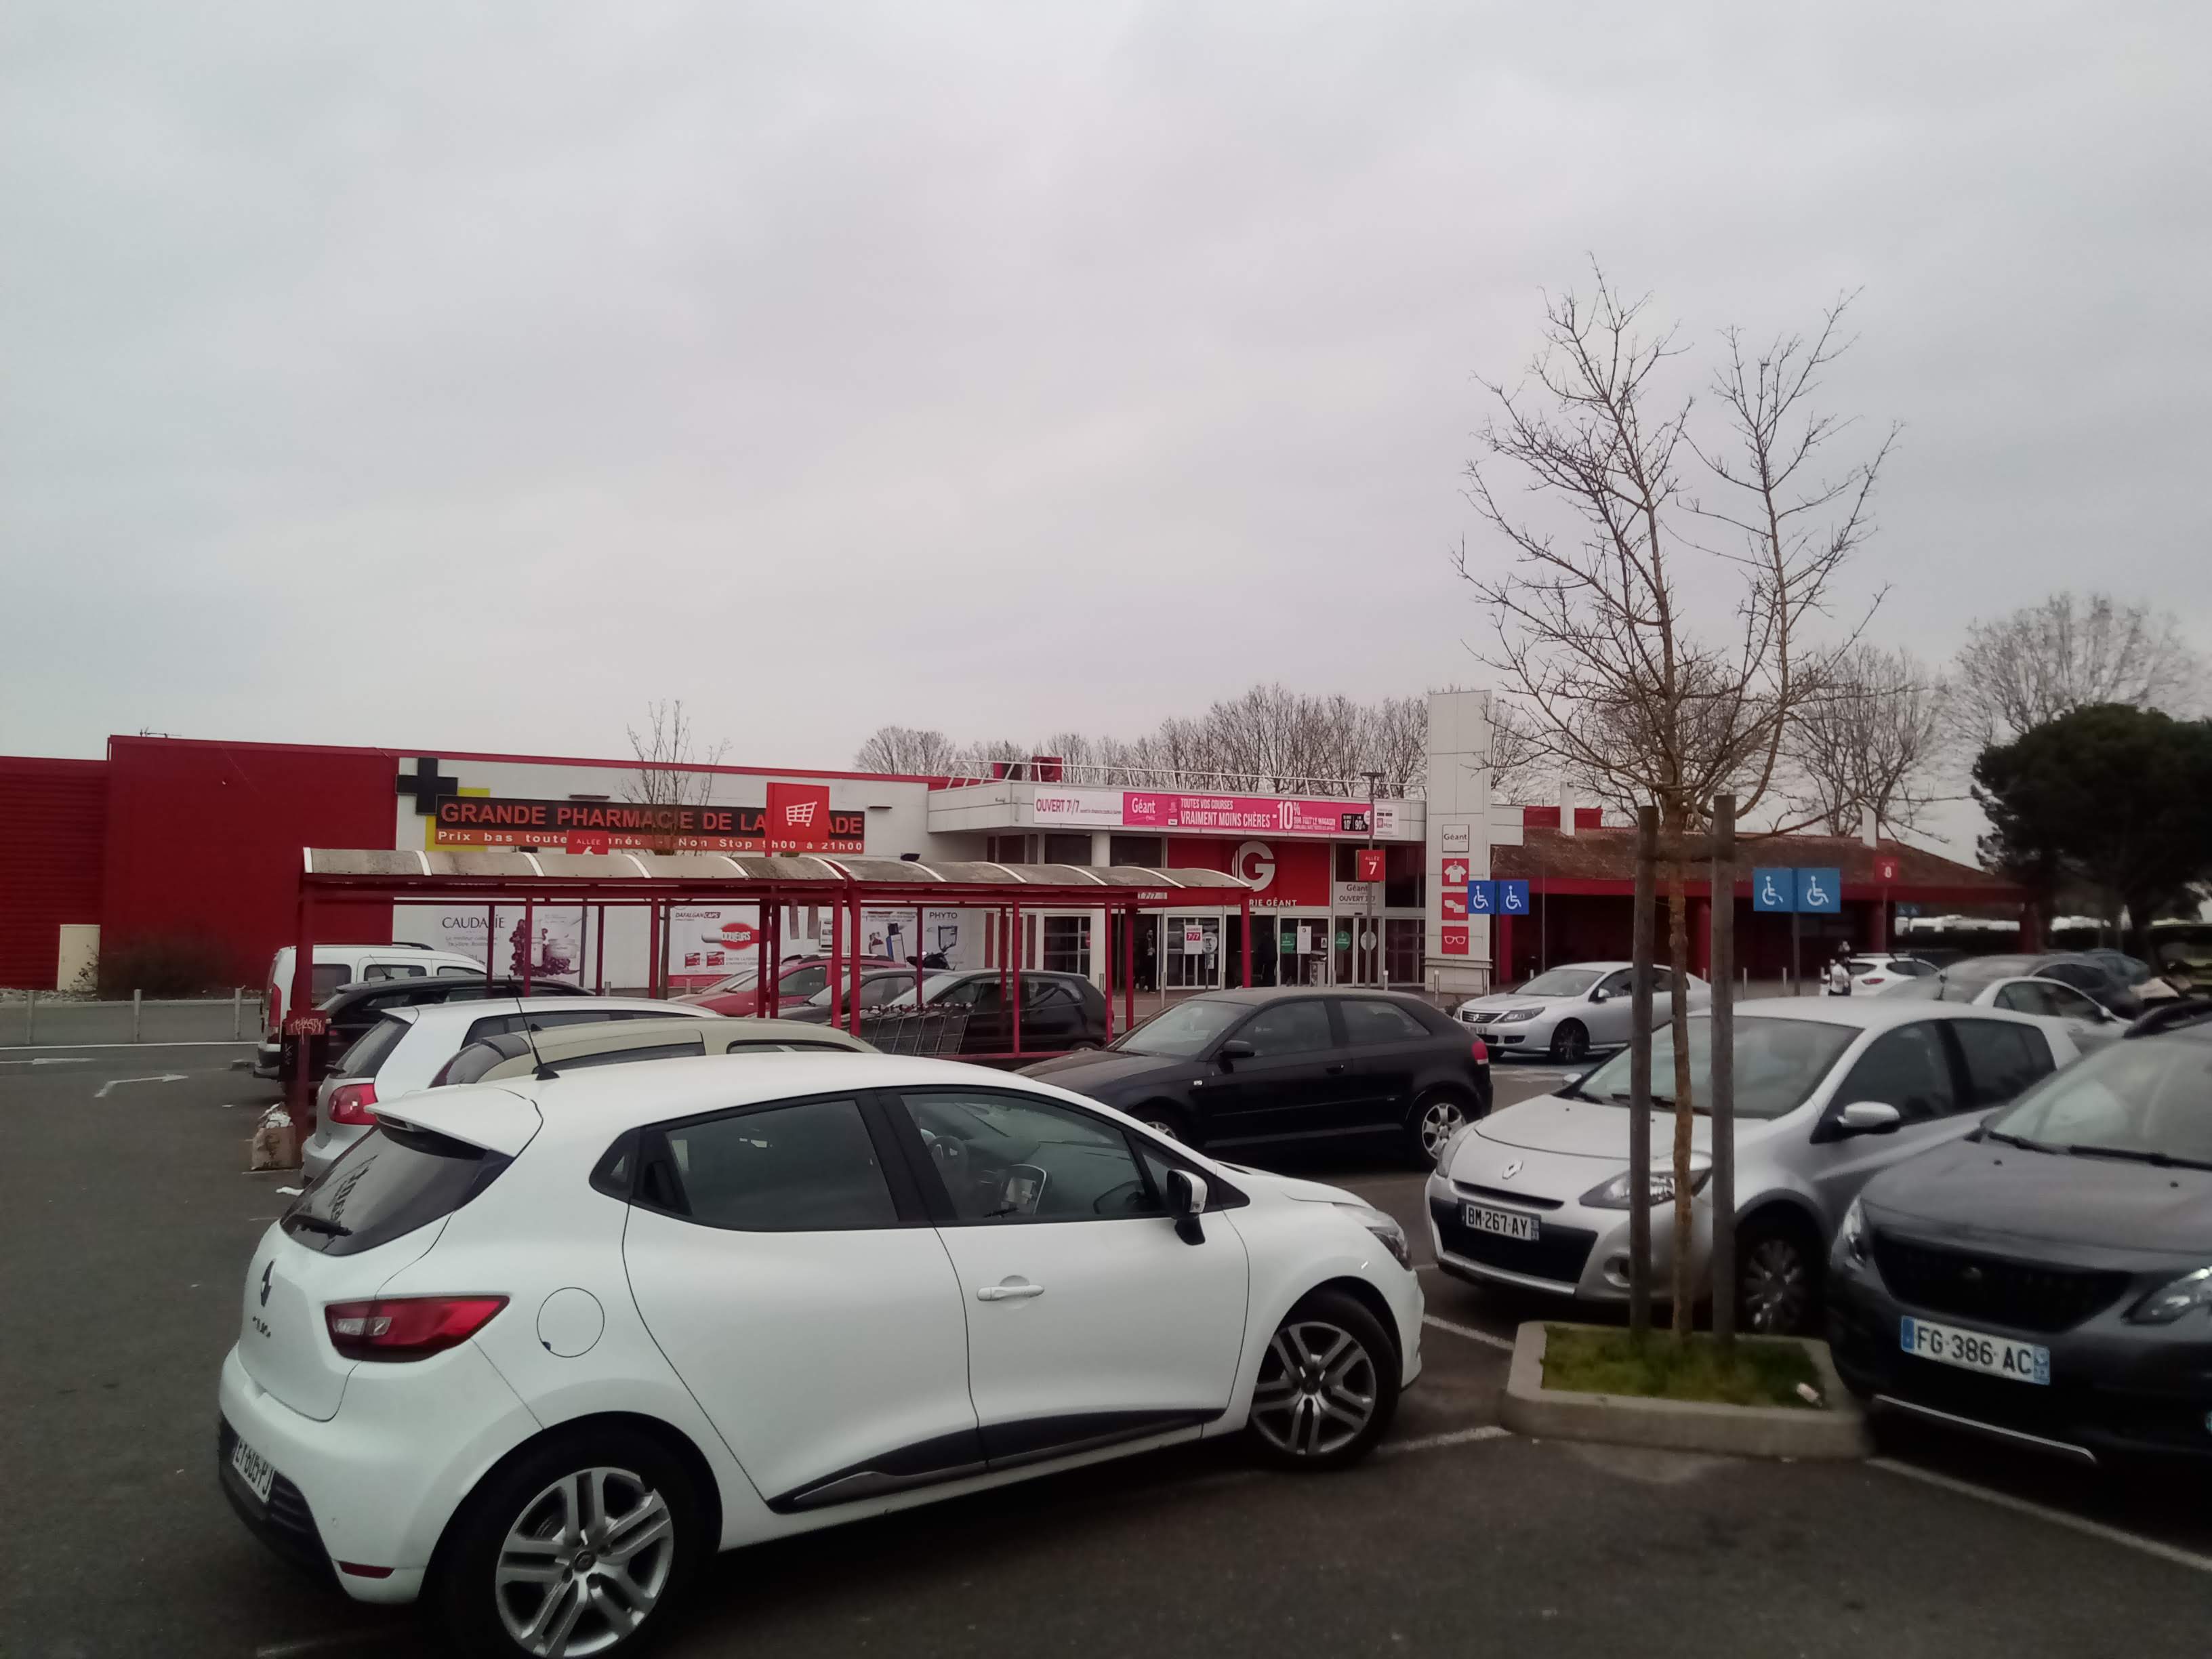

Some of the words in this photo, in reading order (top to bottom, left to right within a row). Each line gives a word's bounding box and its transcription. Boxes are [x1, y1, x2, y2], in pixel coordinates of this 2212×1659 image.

[1036, 799, 1065, 812] OUVERT
[1067, 800, 1080, 815] 7/7
[1132, 797, 1155, 814] Géant
[1181, 798, 1200, 808] TOUTES
[1200, 799, 1210, 809] VOS
[1211, 800, 1233, 810] COURSES
[441, 803, 547, 825] GRANDE
[557, 807, 694, 830] PHARMACIE
[703, 812, 733, 831] DE
[1181, 811, 1217, 825] VRAIMENT
[1218, 812, 1242, 827] MOINS
[1243, 812, 1270, 828] CHÈRES
[438, 831, 471, 841] Prix
[484, 832, 514, 842] bas
[525, 834, 567, 844] toute
[678, 838, 708, 846] Non
[719, 838, 753, 850] Stop
[821, 842, 863, 851] 21h00
[1369, 861, 1377, 875] 7
[1266, 897, 1297, 907] GÉANT
